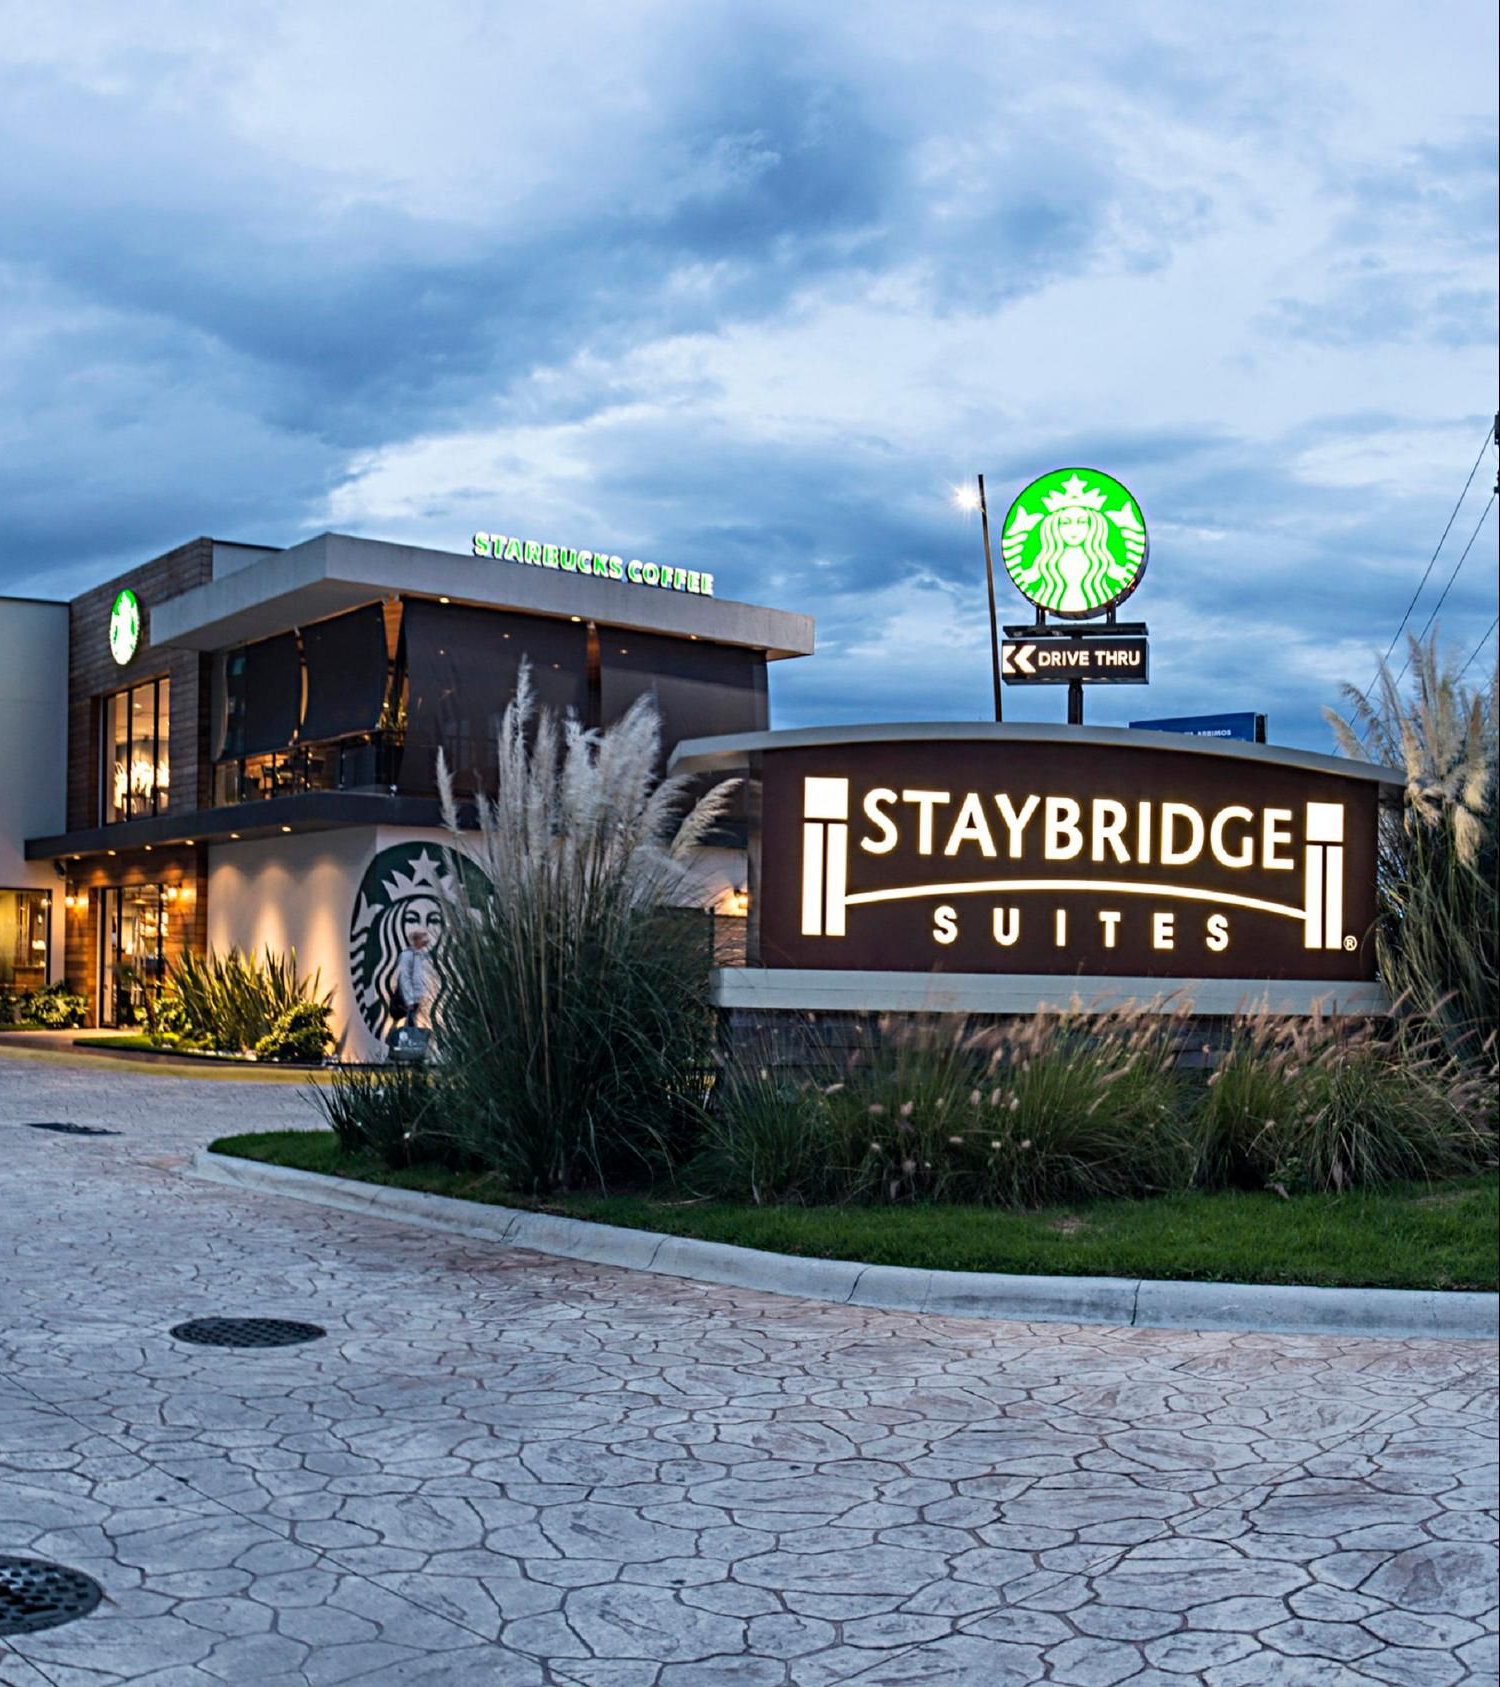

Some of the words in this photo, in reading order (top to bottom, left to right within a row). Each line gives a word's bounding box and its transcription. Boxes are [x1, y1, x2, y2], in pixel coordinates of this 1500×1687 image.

[473, 531, 624, 580] STARBUCKS
[627, 559, 715, 597] COFFEE
[1038, 650, 1090, 666] DRIVE
[1094, 650, 1141, 666] THRU
[859, 787, 1296, 870] STAYBRIDGE
[932, 905, 1230, 952] SUITES
